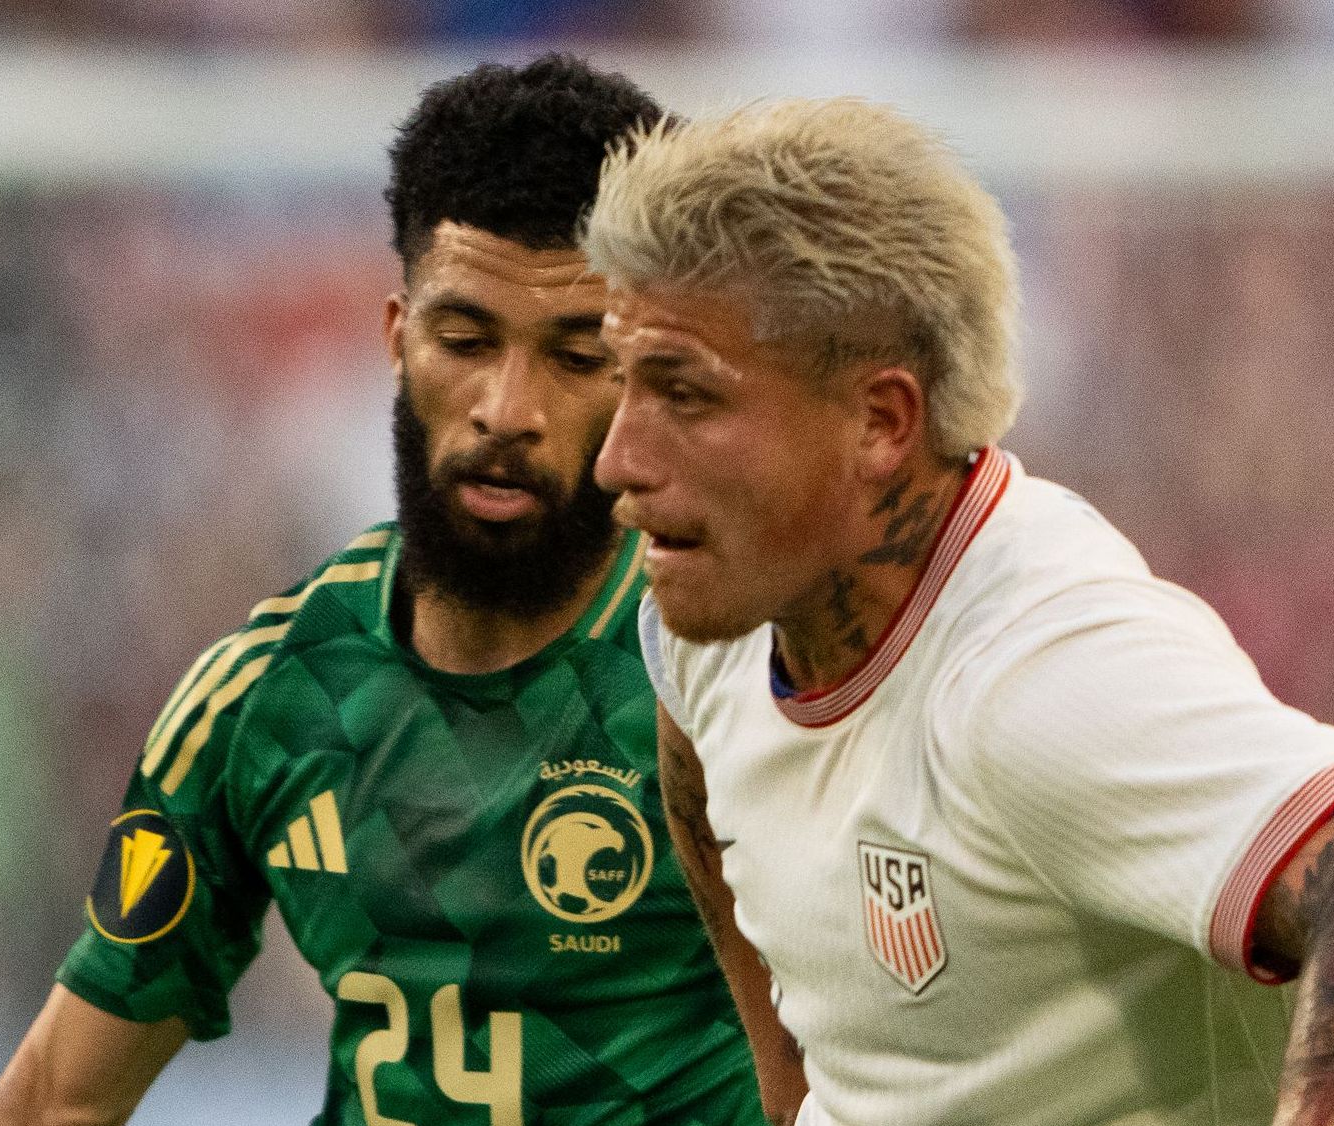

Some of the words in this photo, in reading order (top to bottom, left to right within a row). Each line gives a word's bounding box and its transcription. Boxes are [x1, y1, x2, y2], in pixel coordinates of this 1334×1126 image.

[540, 759, 642, 788] السعودية
[588, 868, 626, 882] SAFF
[865, 852, 926, 911] USA
[548, 934, 621, 953] SAUDI
